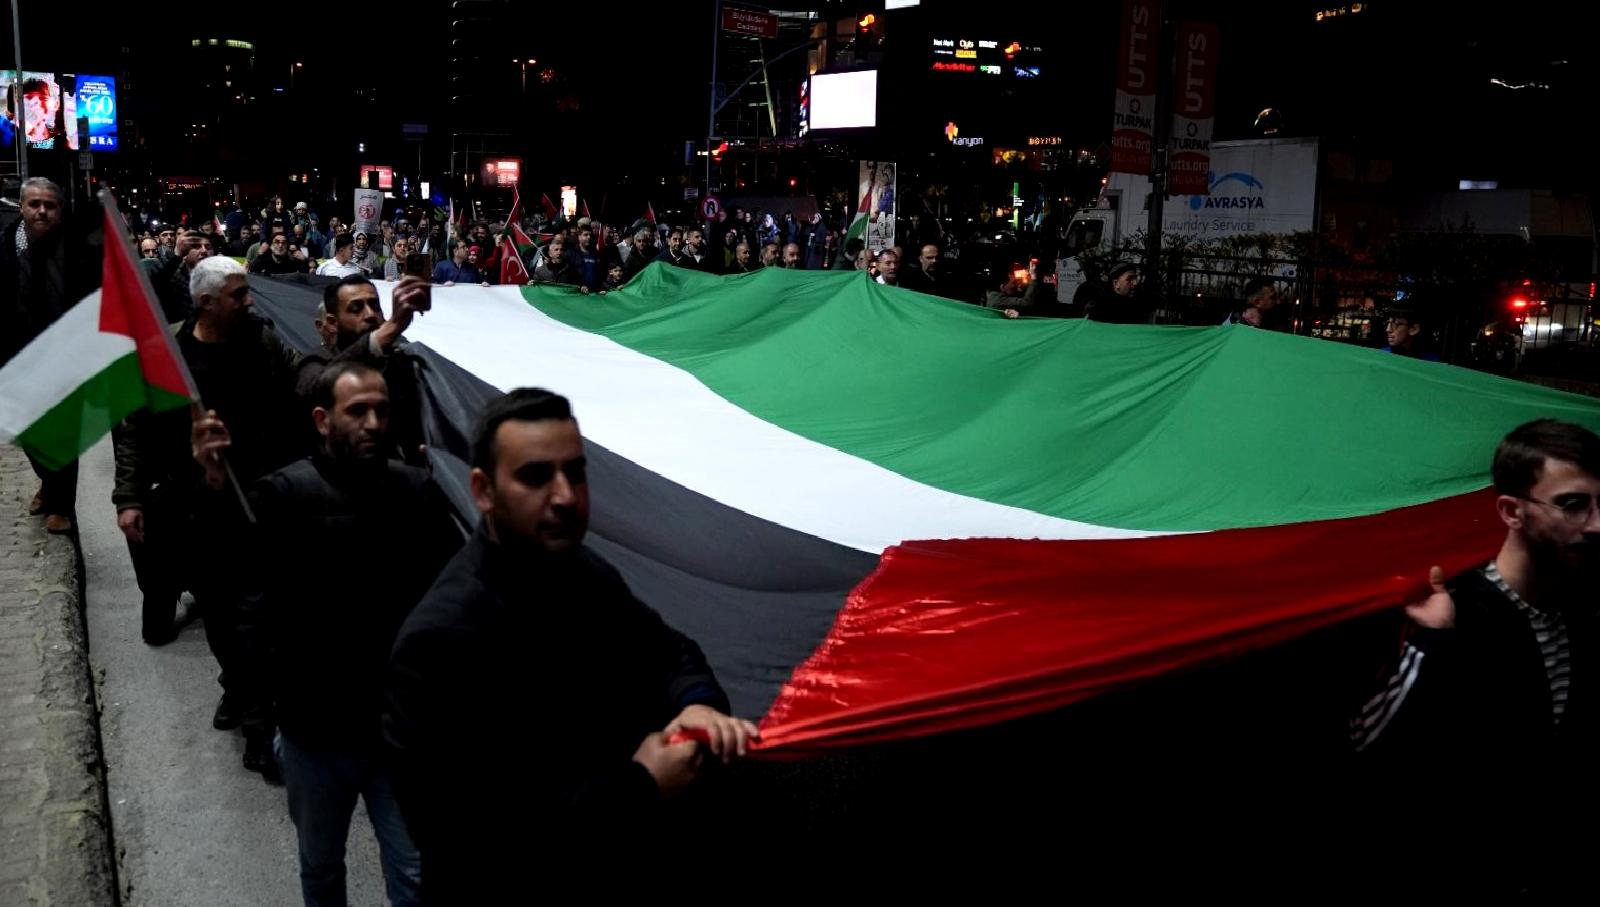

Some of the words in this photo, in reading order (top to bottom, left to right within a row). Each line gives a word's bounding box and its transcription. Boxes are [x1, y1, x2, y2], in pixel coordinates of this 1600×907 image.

[1128, 4, 1150, 89] UTTS
[1184, 32, 1207, 113] UTTS
[1115, 113, 1152, 129] TURPAK
[953, 137, 983, 147] kanyon
[1172, 137, 1210, 150] TURPAK
[1204, 197, 1264, 209] AVRASYA
[1164, 220, 1207, 234] Laundry
[1213, 219, 1255, 231] Service
